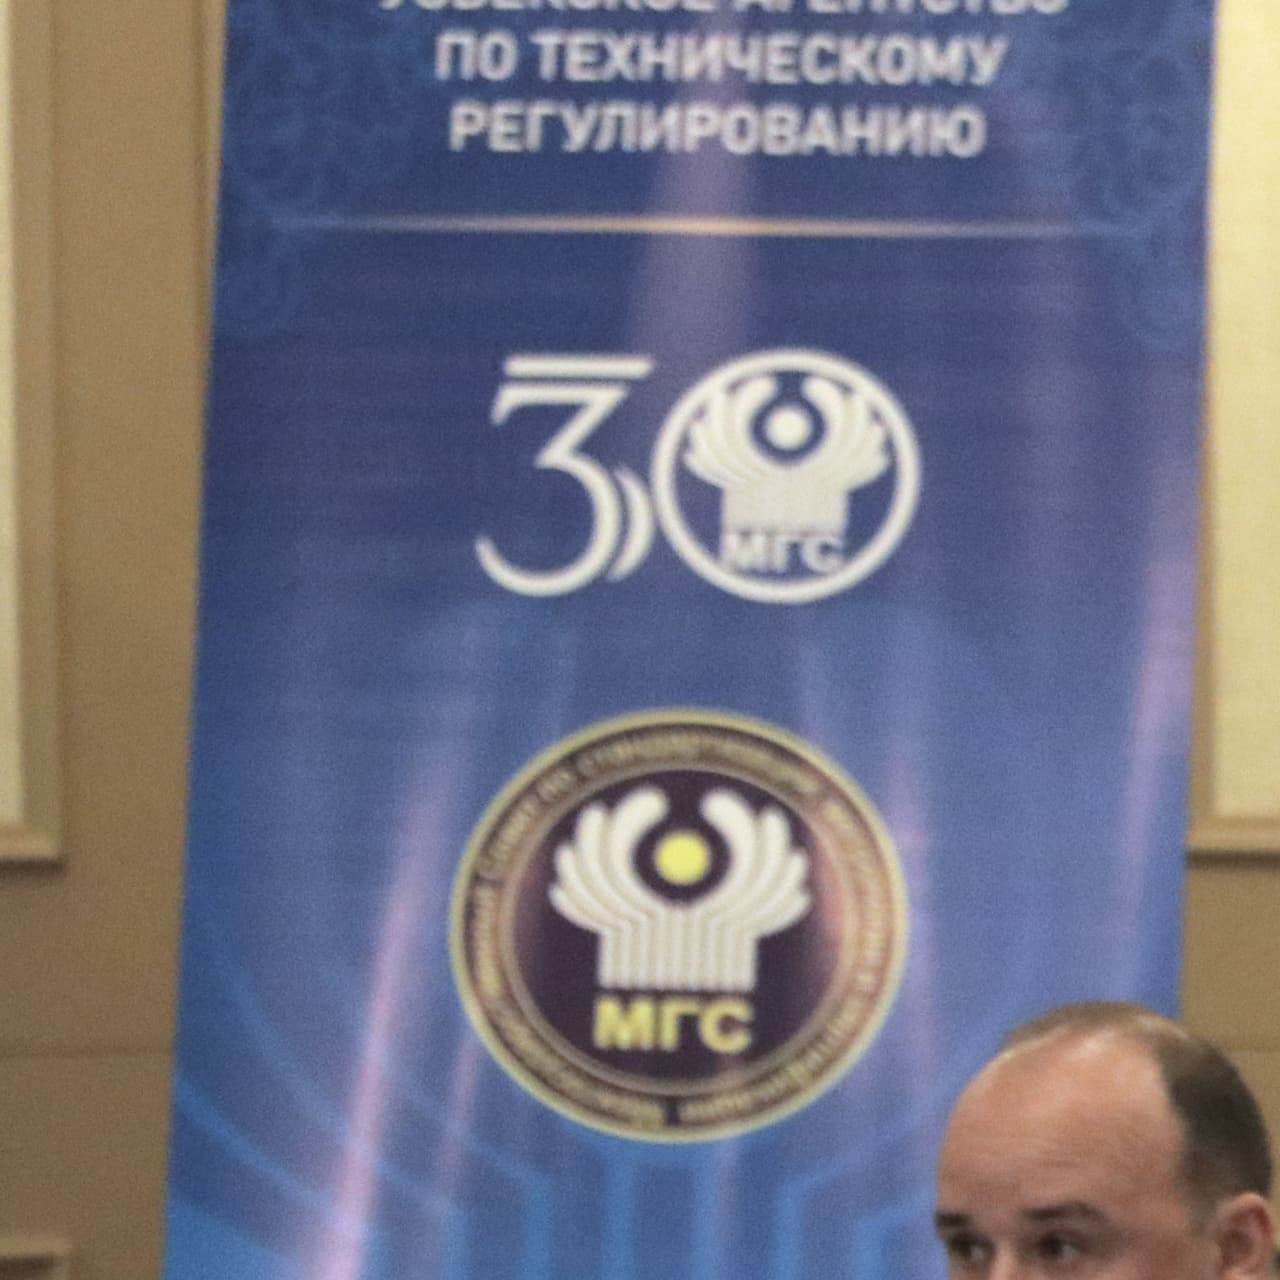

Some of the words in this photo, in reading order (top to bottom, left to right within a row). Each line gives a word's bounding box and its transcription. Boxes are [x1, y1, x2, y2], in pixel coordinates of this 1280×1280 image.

[434, 29, 519, 81] ПО
[531, 29, 1010, 86] ТЕХНИЧЕСКОМУ
[451, 100, 987, 158] РЕГУЛИРОВАНИЮ
[592, 994, 757, 1054] МГС
